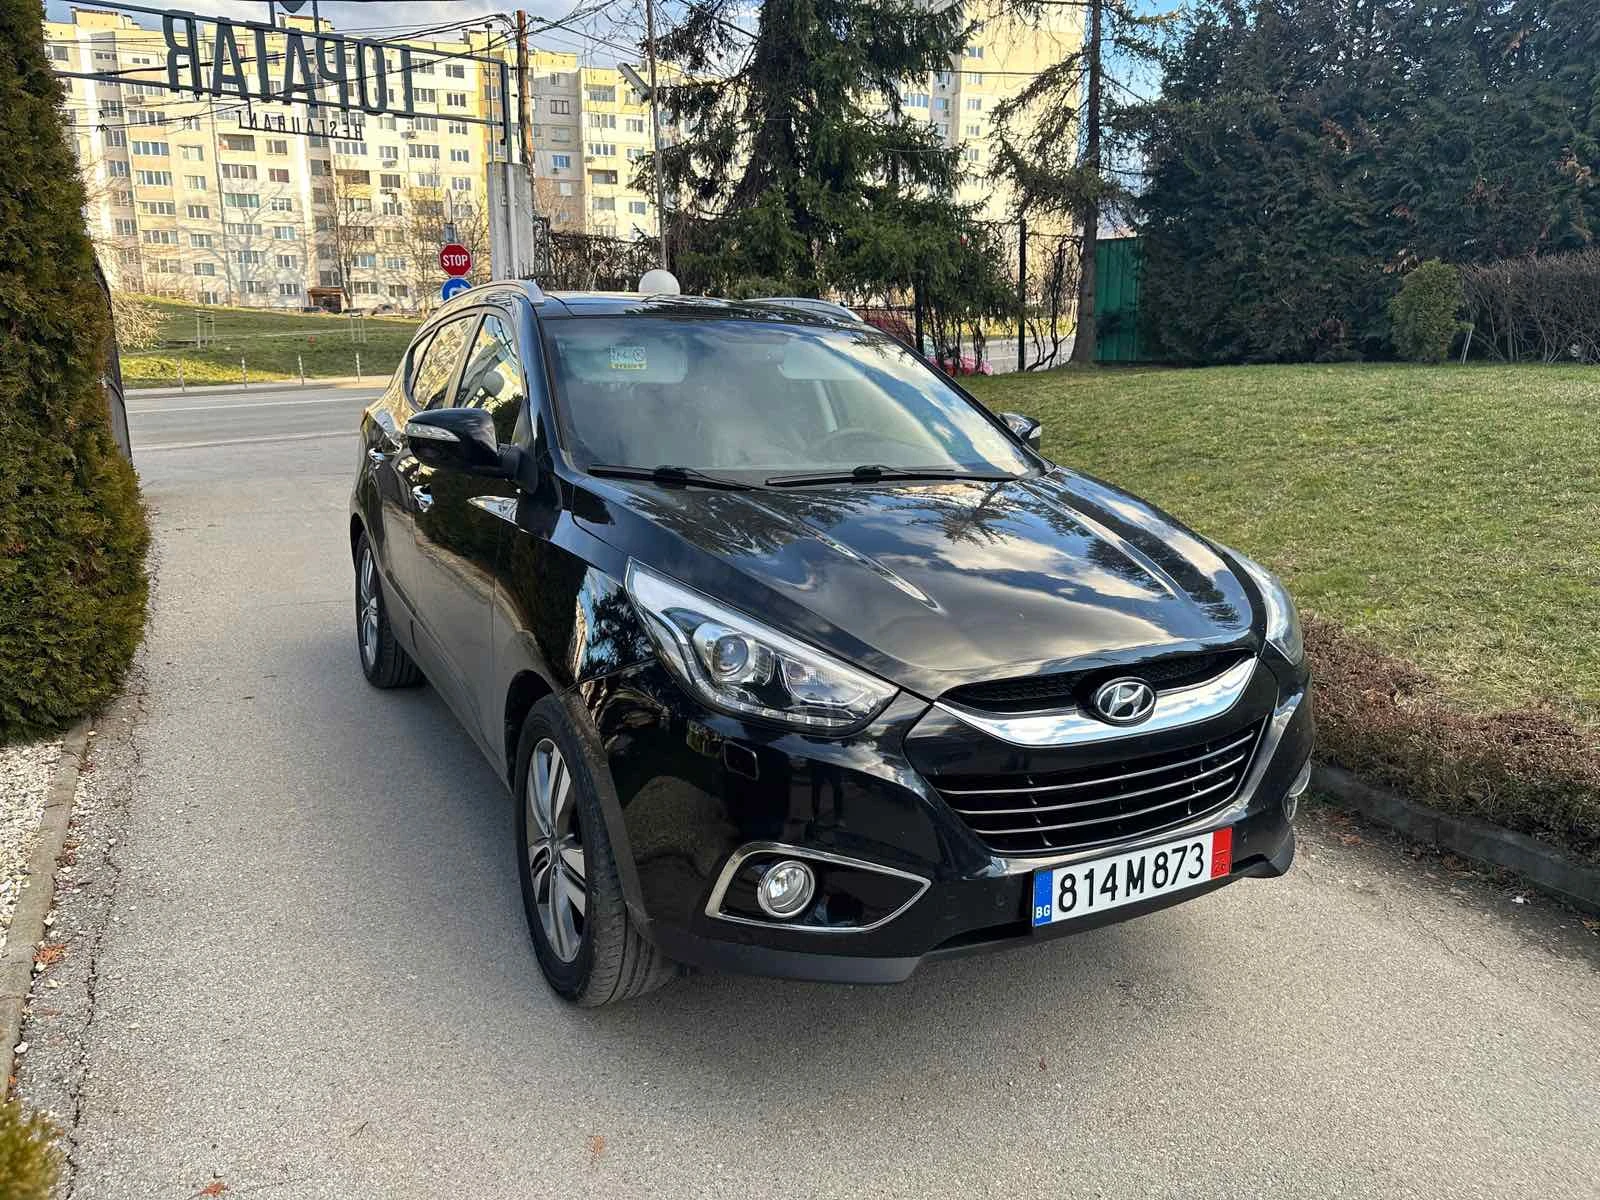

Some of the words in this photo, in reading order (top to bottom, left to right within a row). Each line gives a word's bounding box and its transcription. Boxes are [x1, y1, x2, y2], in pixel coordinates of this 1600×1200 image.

[442, 254, 468, 267] STOP
[1035, 905, 1051, 919] BG
[1058, 842, 1205, 913] 814M873
